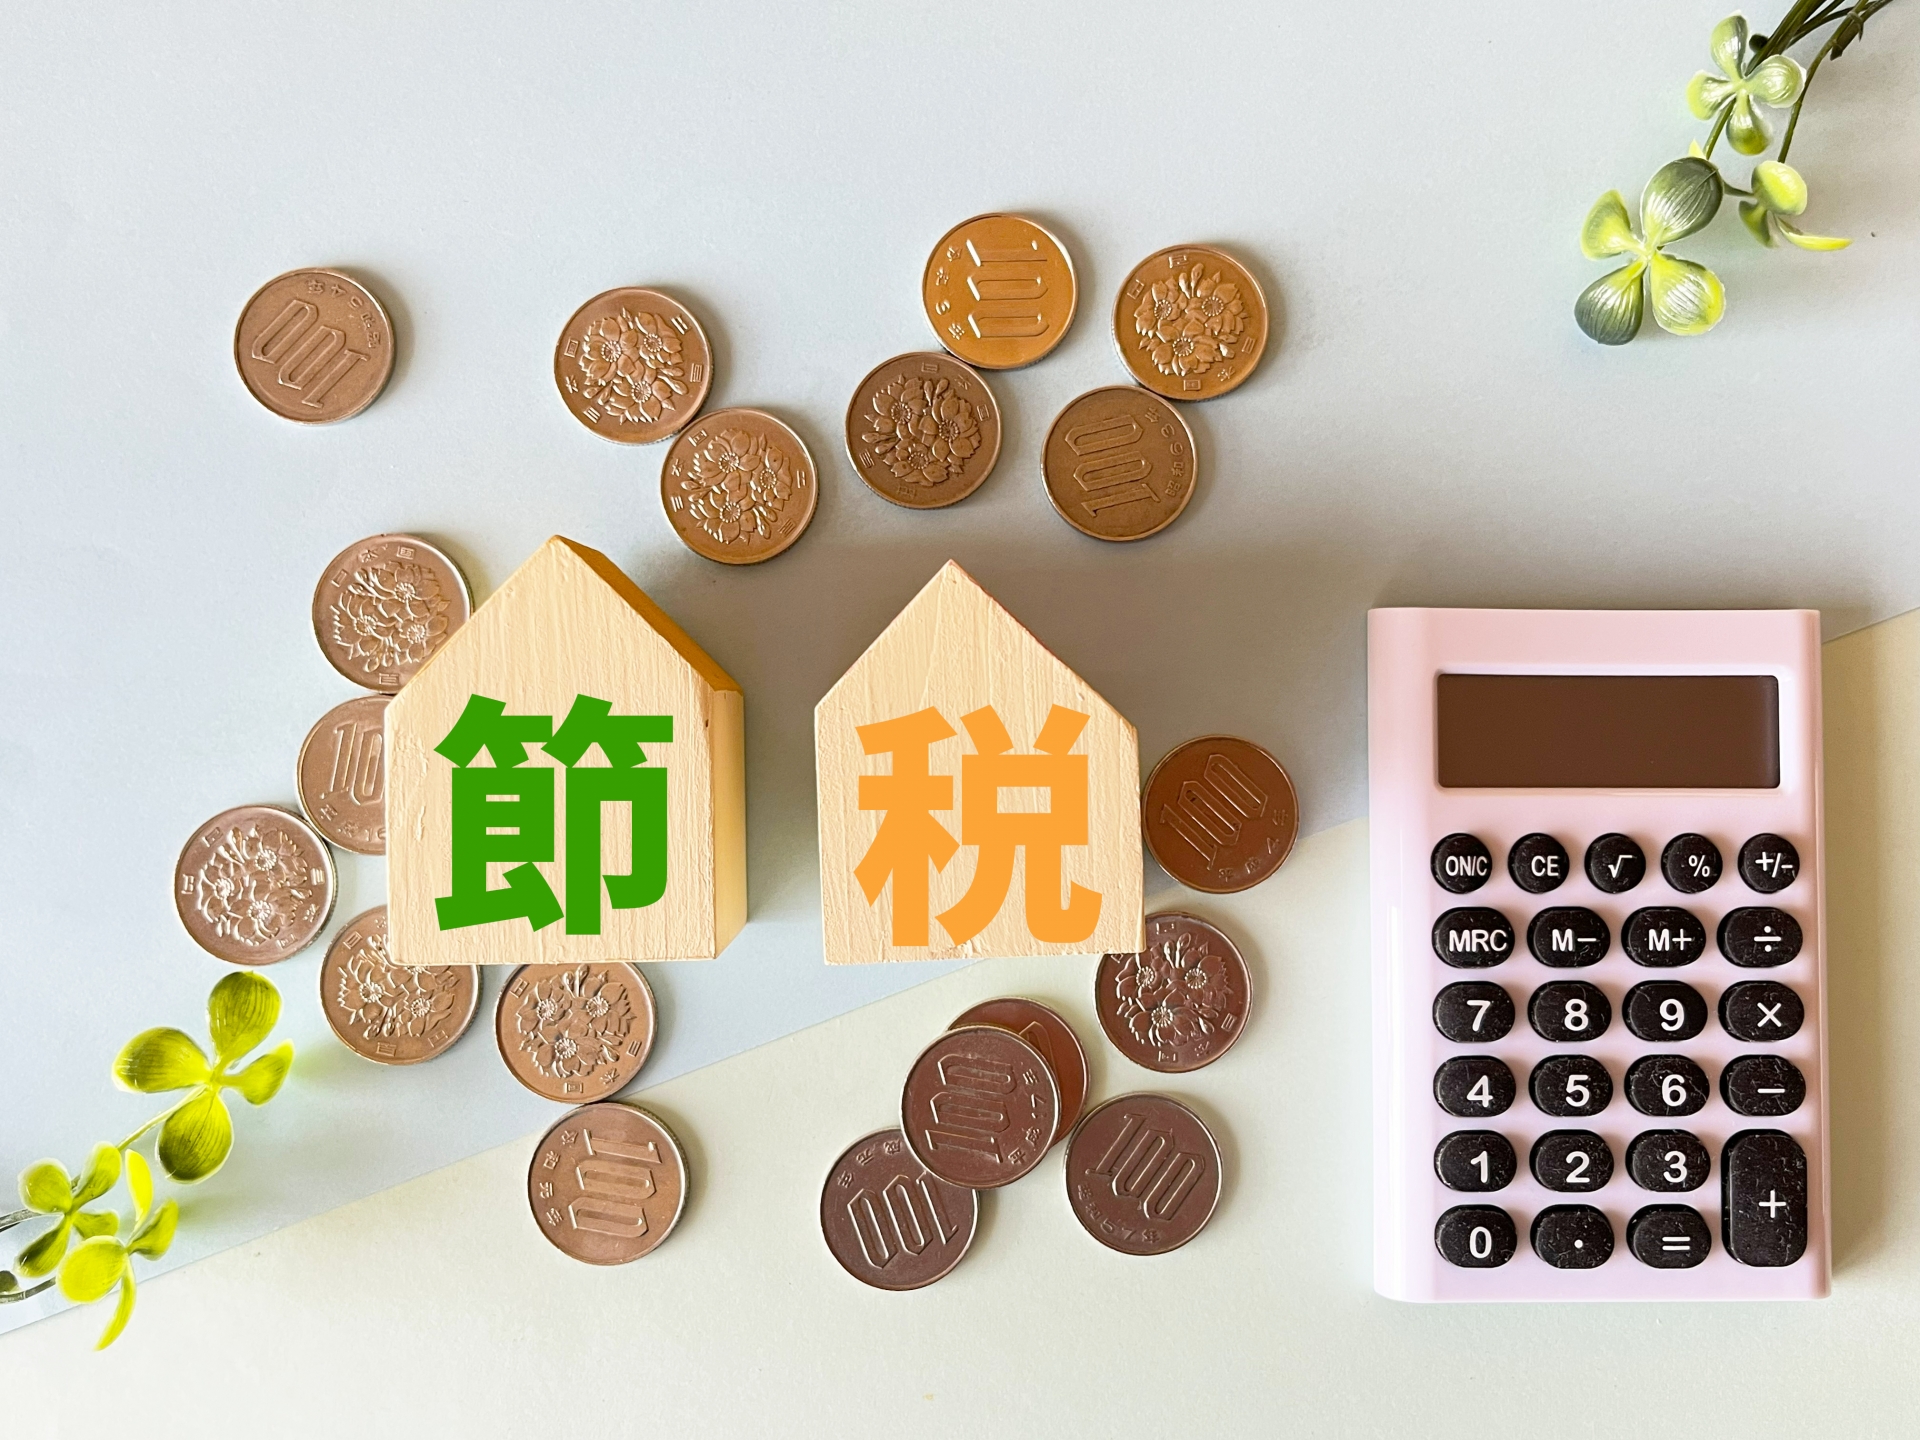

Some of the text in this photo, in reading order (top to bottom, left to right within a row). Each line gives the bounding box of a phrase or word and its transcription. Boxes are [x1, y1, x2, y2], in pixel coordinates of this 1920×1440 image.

[966, 238, 1049, 339] 100
[251, 299, 371, 408] 100
[1064, 414, 1160, 517] 100
[319, 721, 385, 806] 10
[1160, 753, 1268, 871] 100
[1445, 855, 1487, 877] ON/C
[1532, 855, 1559, 877] CE
[1449, 929, 1507, 952] MRC
[1648, 929, 1692, 951] M+
[1467, 1000, 1491, 1031] 7
[1564, 999, 1589, 1031] 8
[1659, 999, 1684, 1031] 9
[925, 1053, 1018, 1163] 100
[1466, 1075, 1493, 1107] 4
[1565, 1074, 1590, 1107] 5
[1661, 1074, 1686, 1107] 6
[568, 1128, 661, 1238] 100
[1084, 1113, 1205, 1221] 100
[1470, 1151, 1488, 1183] 1
[1565, 1151, 1590, 1183] 2
[1663, 1151, 1687, 1183] 3
[846, 1170, 959, 1269] 100
[1469, 1227, 1492, 1258] 0
